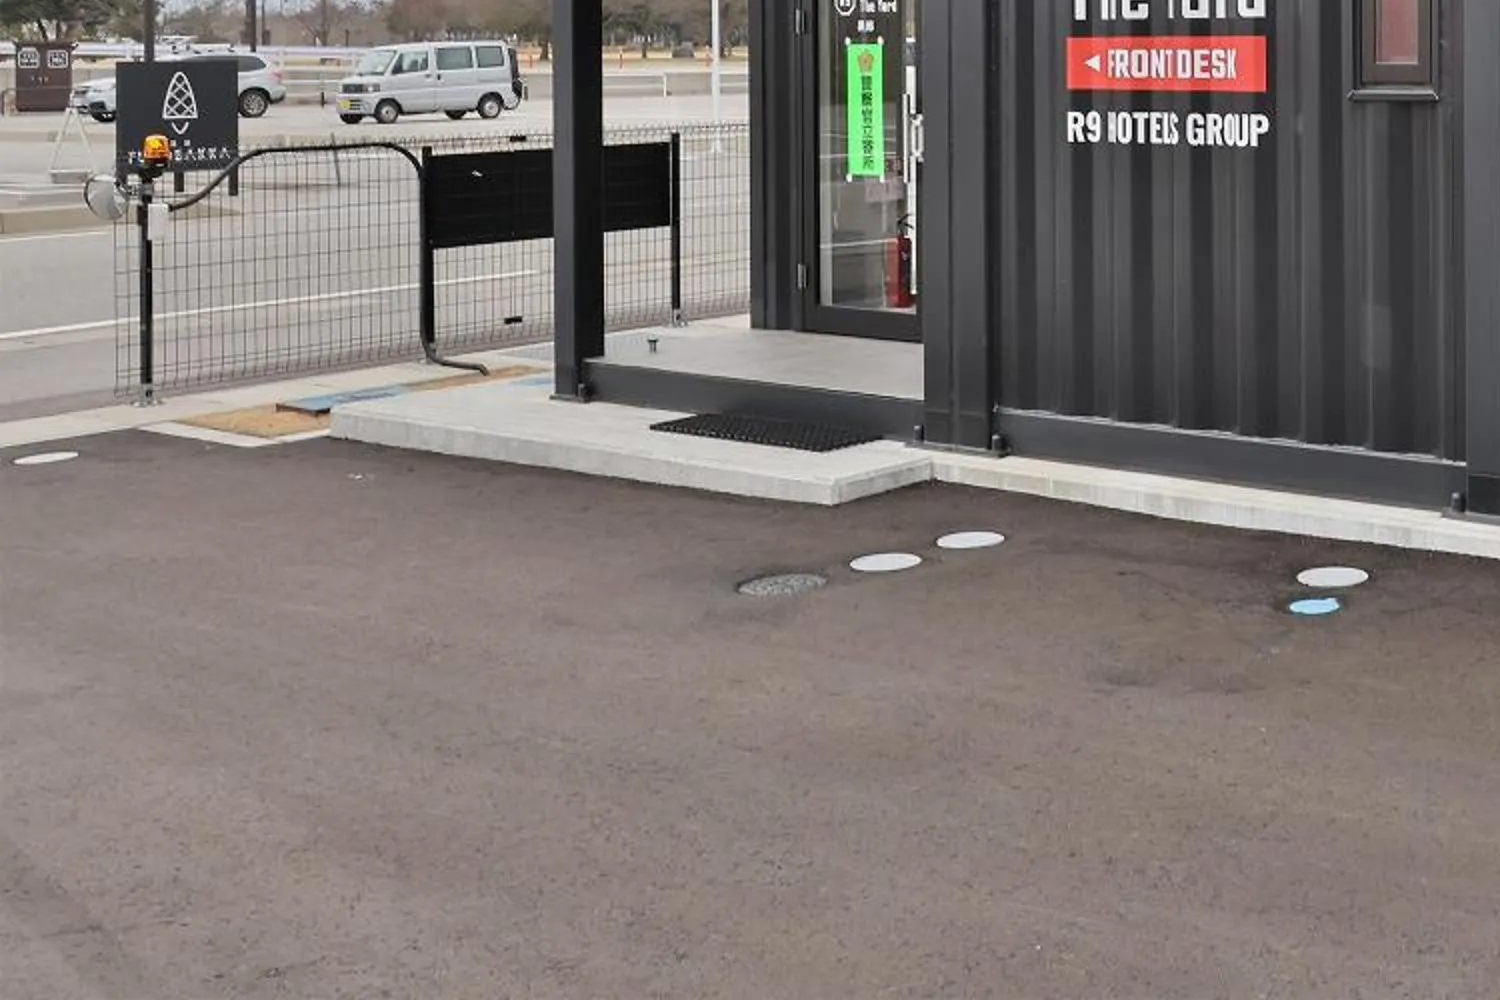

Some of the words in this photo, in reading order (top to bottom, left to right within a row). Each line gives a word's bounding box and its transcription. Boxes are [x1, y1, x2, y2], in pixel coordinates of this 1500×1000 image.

[1107, 49, 1174, 79] FRONT
[1177, 49, 1237, 79] DESK
[1067, 110, 1101, 143] R9
[1107, 111, 1179, 144] HOTELS
[1186, 113, 1270, 147] GROUP
